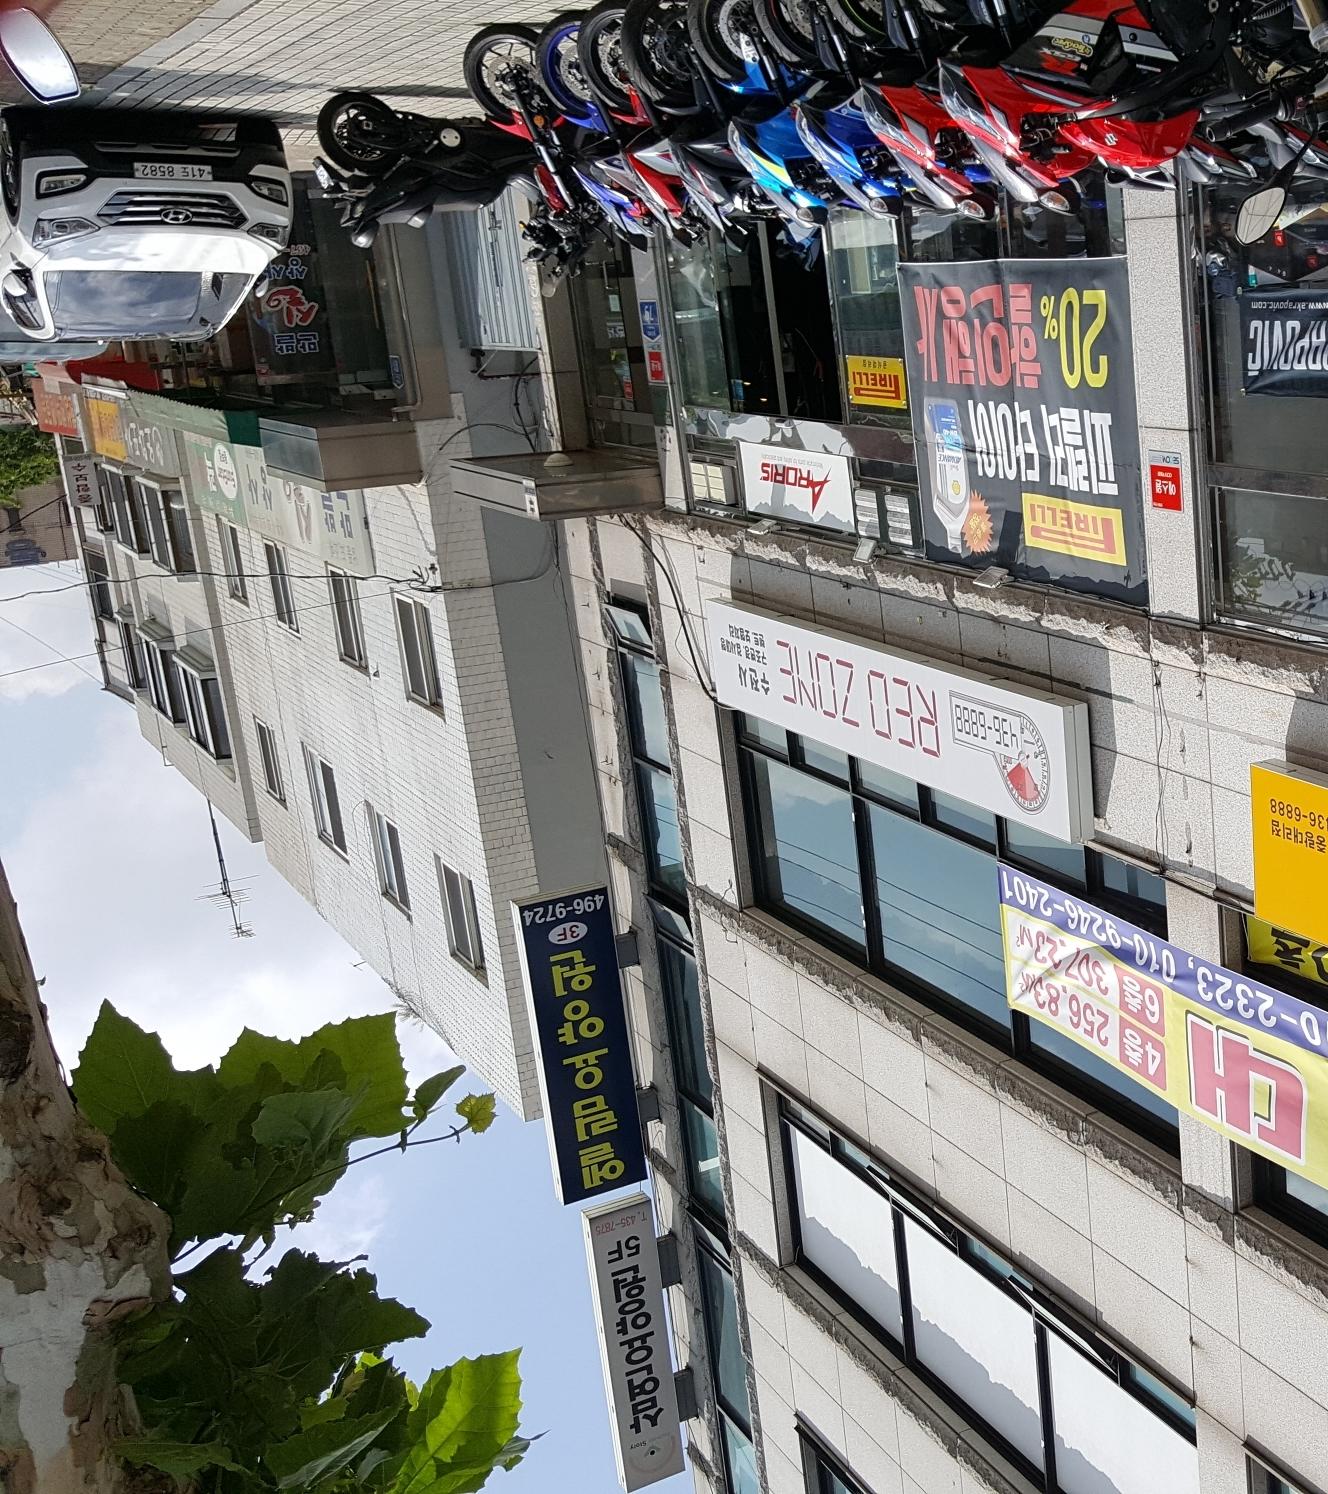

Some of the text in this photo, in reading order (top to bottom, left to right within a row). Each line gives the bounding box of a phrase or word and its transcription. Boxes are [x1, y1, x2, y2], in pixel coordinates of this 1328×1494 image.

[140, 164, 175, 178] 8582
[912, 281, 1109, 390] 20% 할인행사
[852, 371, 902, 400] PIRELLI
[967, 399, 1119, 496] 피렐리 타이어
[1029, 503, 1117, 556] PIRELLI
[738, 663, 770, 696] 수전사
[776, 639, 860, 729] ZONE
[867, 669, 942, 759] RED
[954, 704, 1019, 750] 436-6888
[1271, 819, 1327, 854] 중랑대리점
[523, 893, 606, 927] 496-9724
[555, 924, 581, 943] 3F
[1001, 869, 1177, 987] 010-9246-2401
[1121, 975, 1161, 1024] 6층
[550, 948, 626, 1191] 엘림요양원
[1122, 1028, 1161, 1077] 4층
[607, 1234, 641, 1263] 5F
